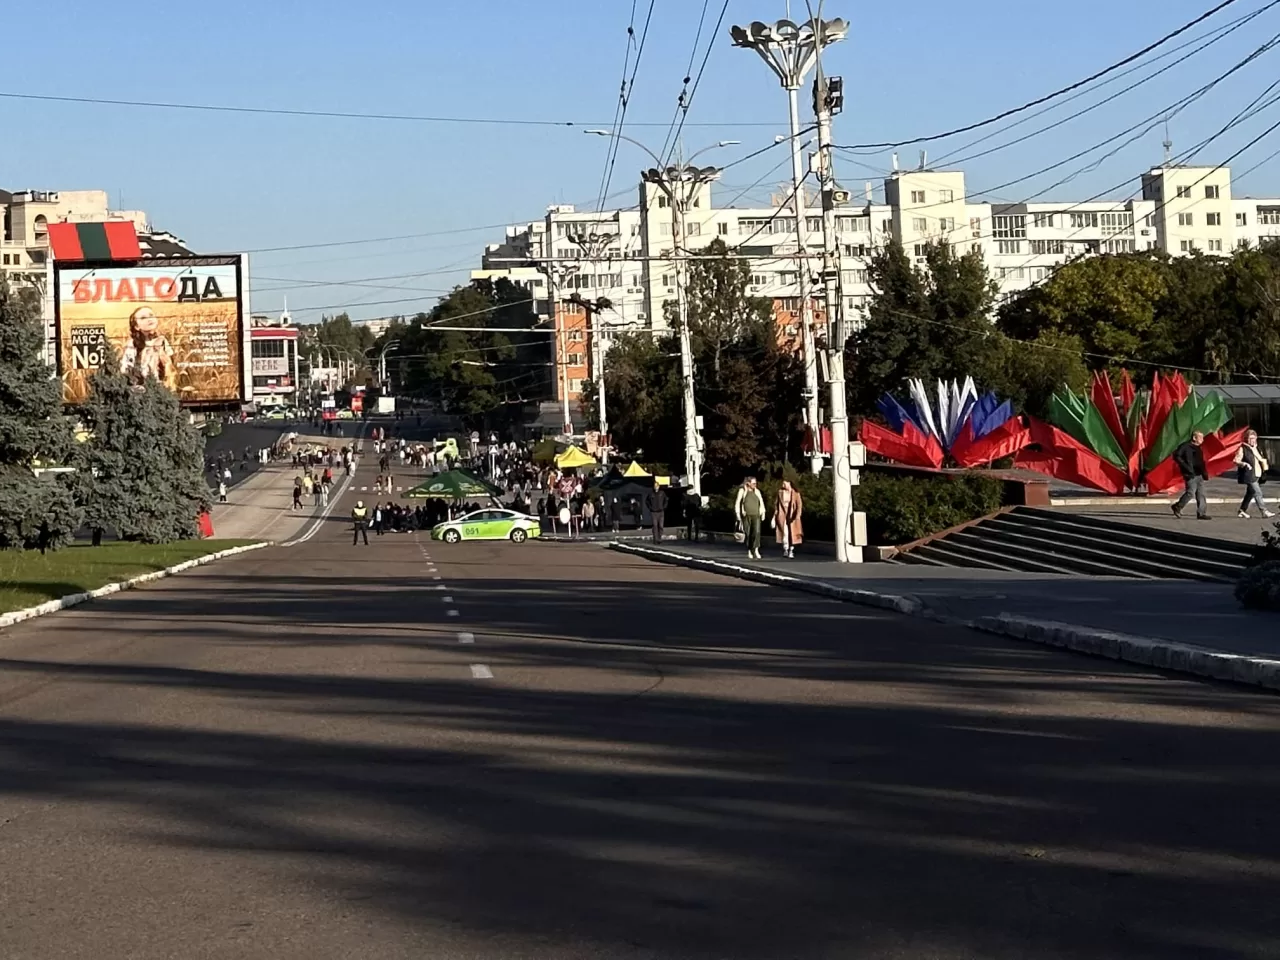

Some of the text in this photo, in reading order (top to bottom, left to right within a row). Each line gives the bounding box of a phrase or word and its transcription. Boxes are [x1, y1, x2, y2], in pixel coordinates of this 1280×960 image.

[71, 276, 224, 304] БЛАГОДА
[71, 328, 105, 336] МОЛОКА
[71, 335, 106, 345] МЯСА
